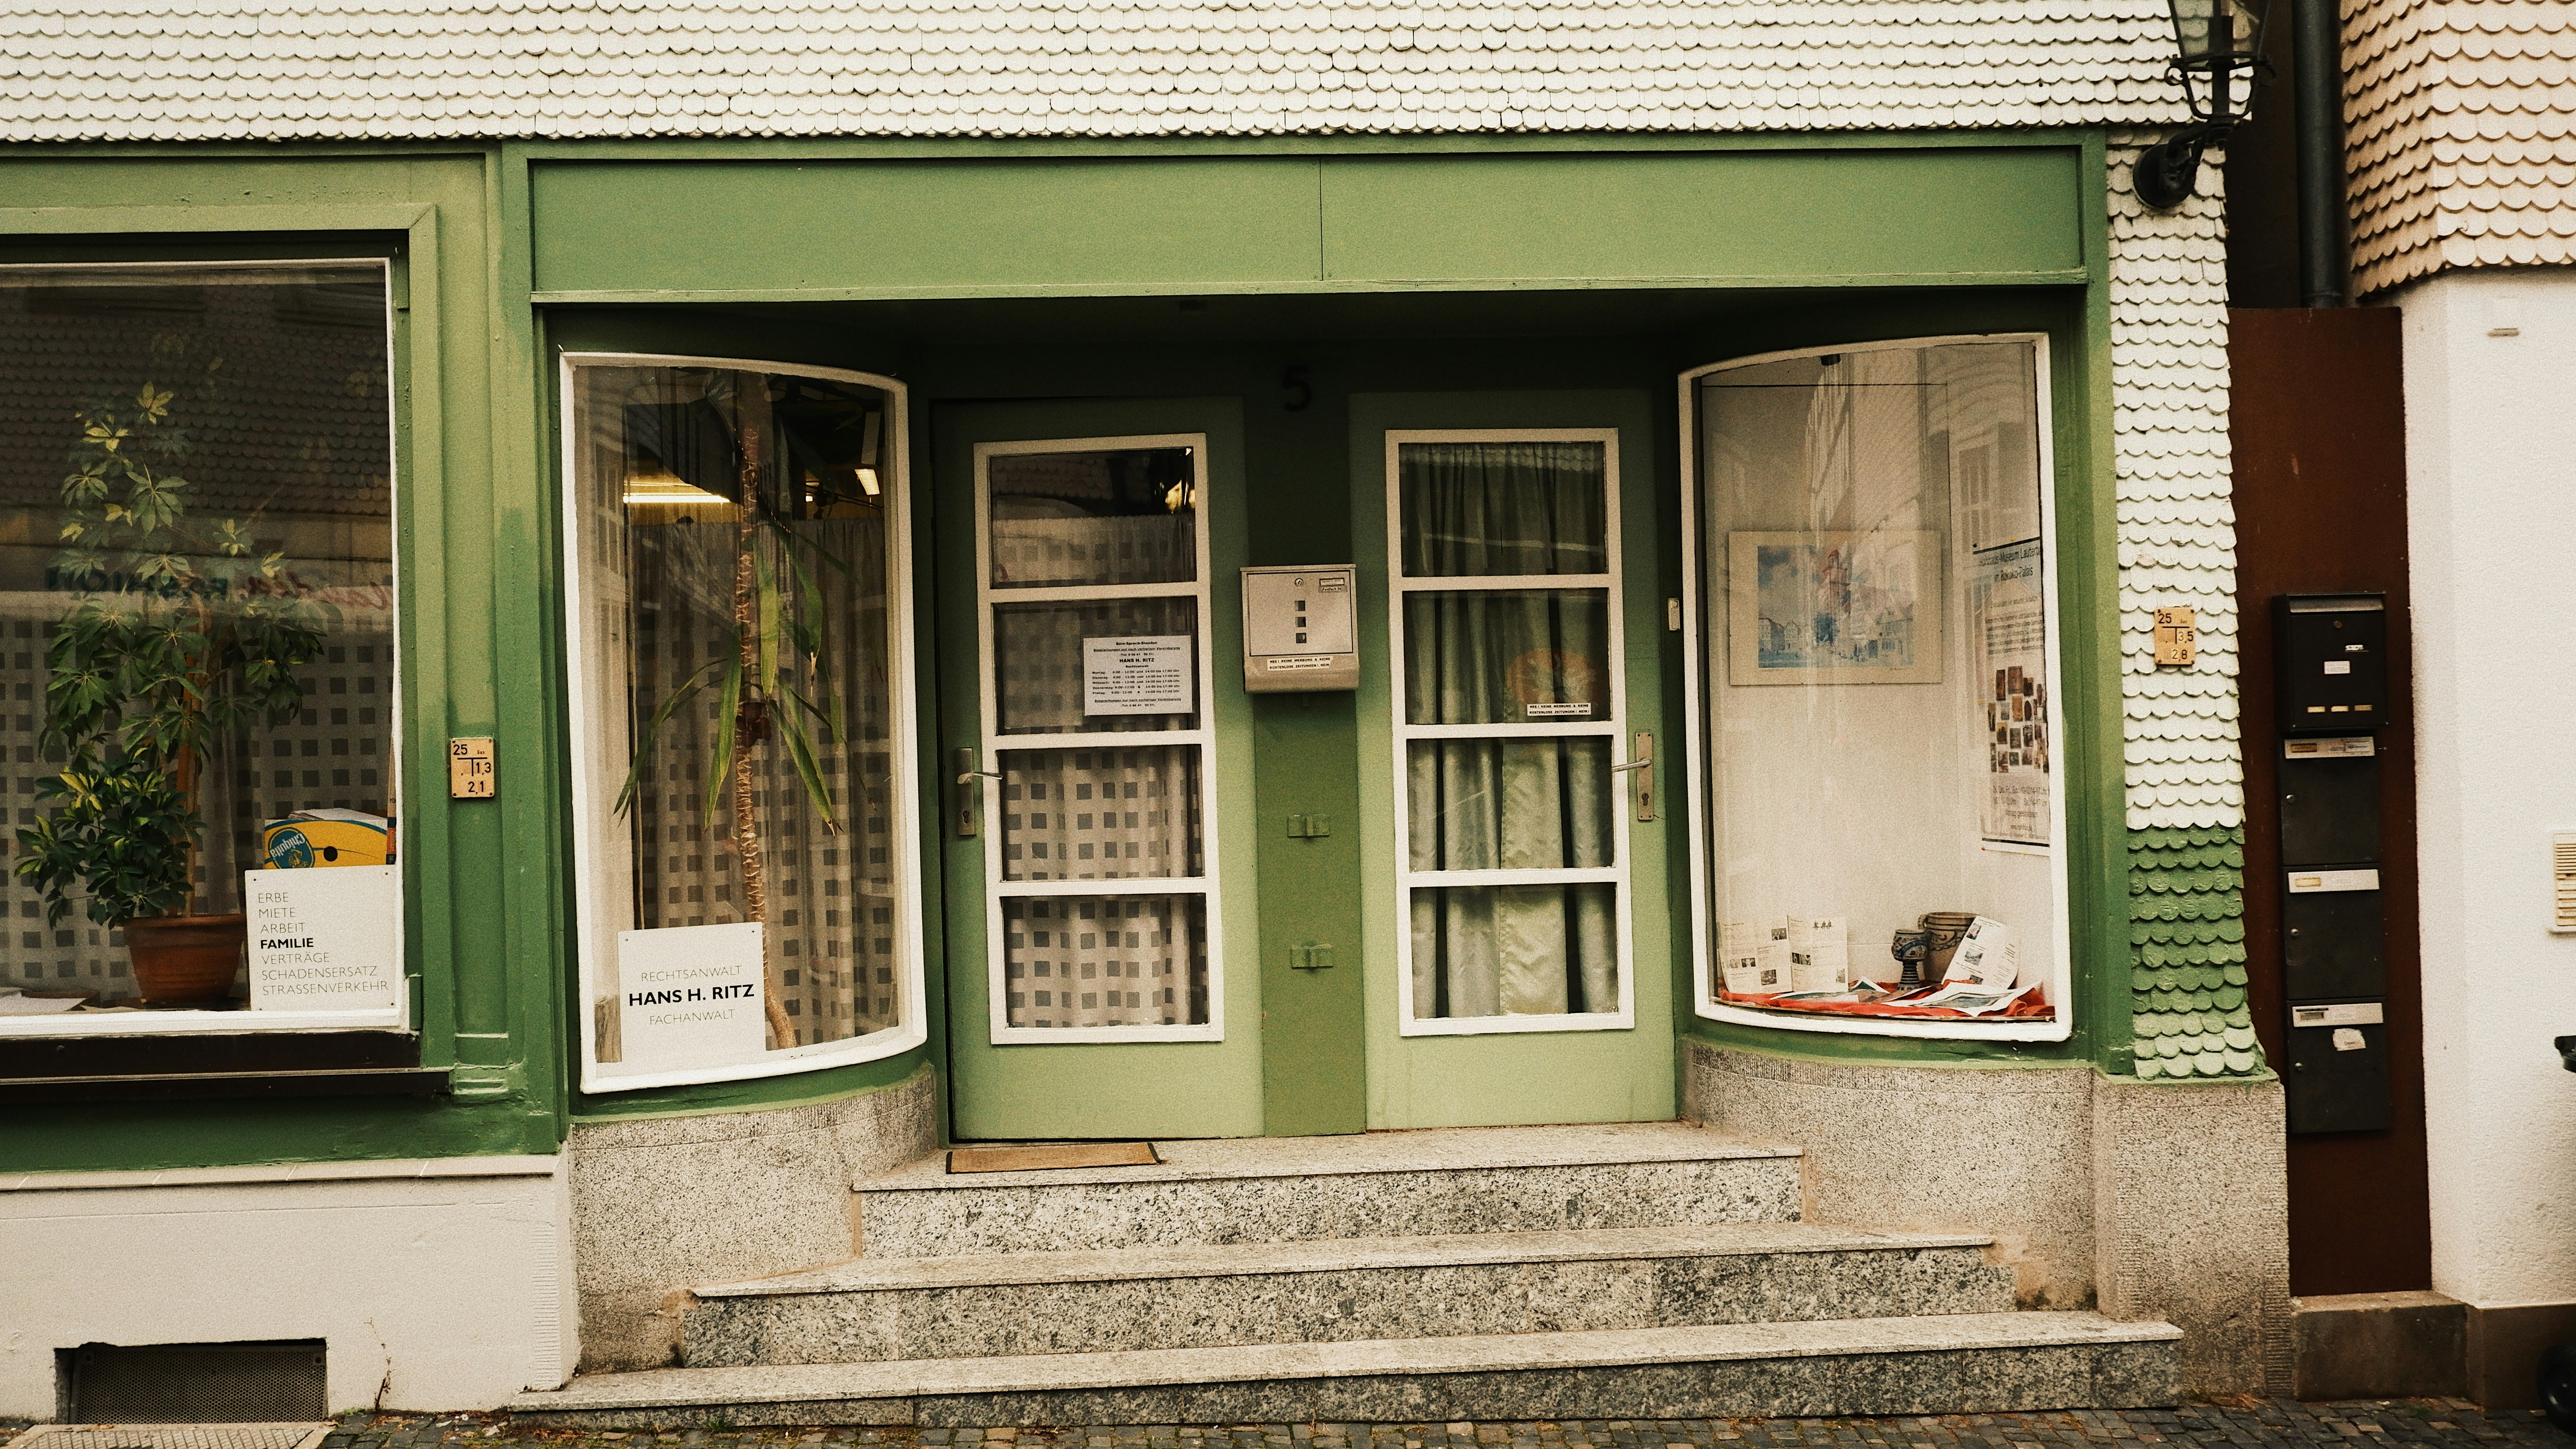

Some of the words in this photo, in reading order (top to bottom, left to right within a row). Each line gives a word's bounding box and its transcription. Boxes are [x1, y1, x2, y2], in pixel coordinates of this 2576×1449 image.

[1283, 364, 1311, 411] 5
[2158, 613, 2172, 624] 25
[2172, 649, 2187, 662] 2,8
[453, 744, 468, 755] 25
[270, 832, 306, 859] Chiquita
[258, 892, 289, 903] ERBE
[258, 907, 296, 919] MIETE
[260, 922, 306, 934] ARBEIT
[260, 937, 314, 949] FAMILIE
[261, 952, 330, 965] VERTRÄGE
[262, 965, 378, 980] SCHADENSERSATZ
[641, 965, 742, 982] RECHTSANWALT
[262, 980, 389, 996] STRASSENVERKEHR
[629, 990, 682, 1006] HANS
[688, 988, 706, 1002] H.
[712, 984, 755, 1000] RITZ
[650, 1009, 735, 1025] FACHANWALT
